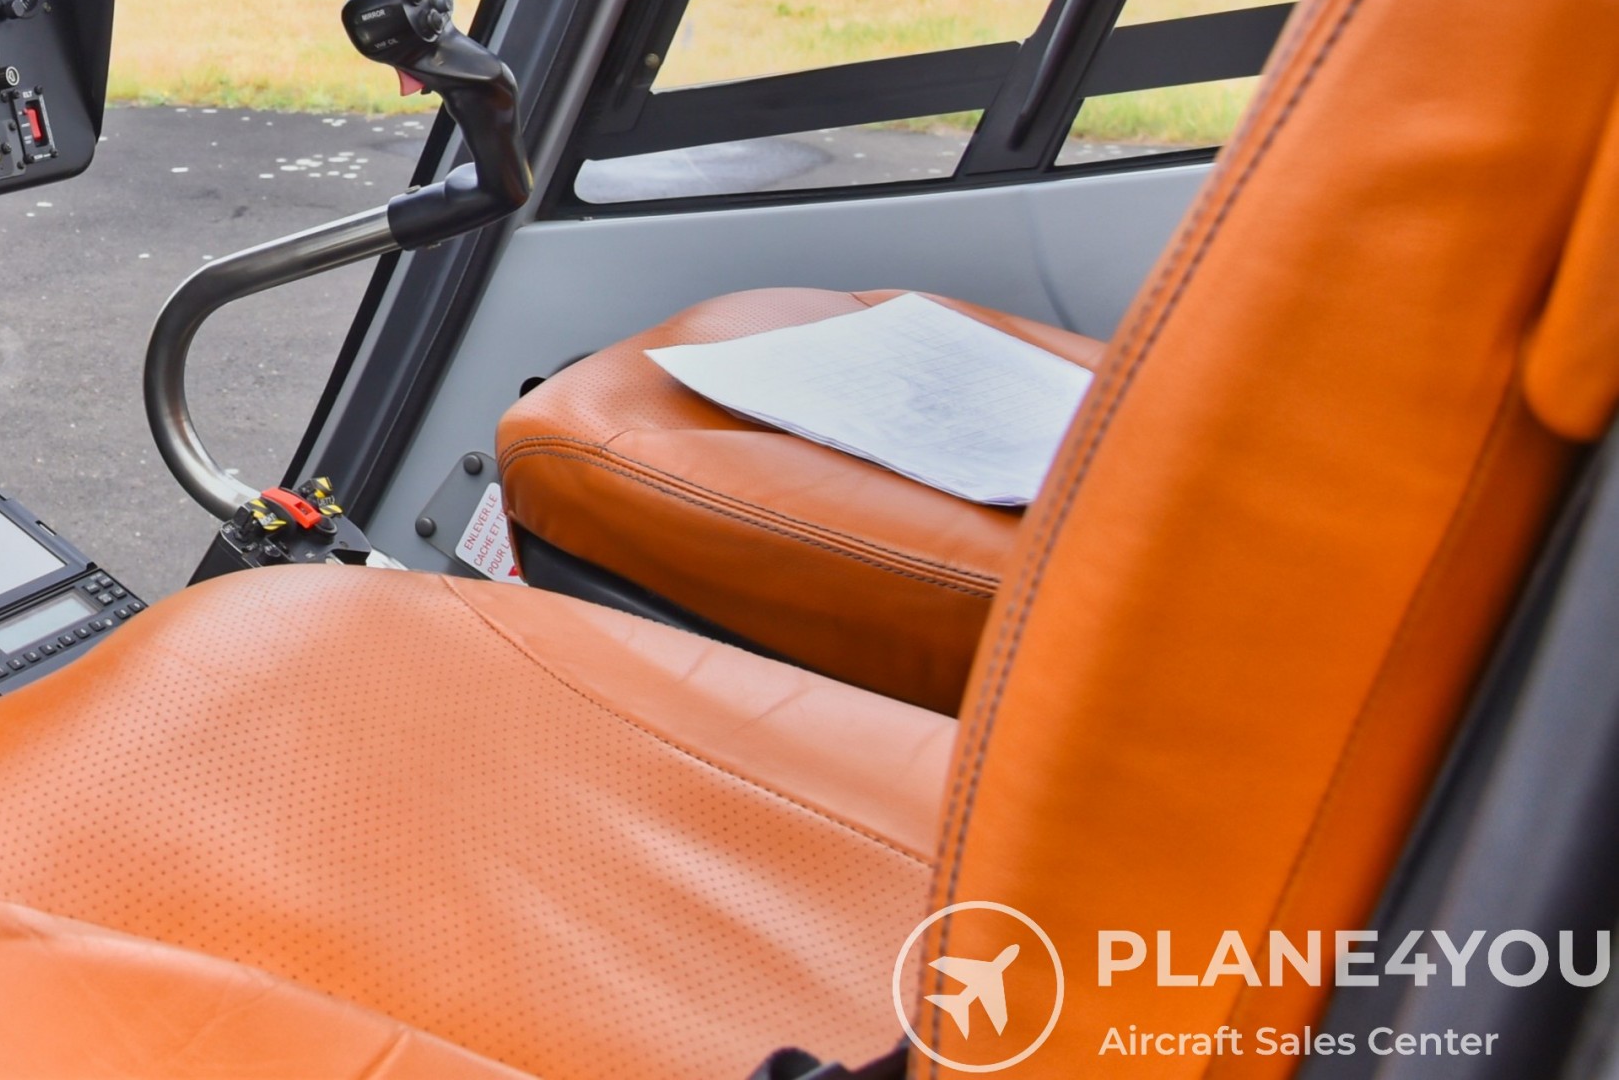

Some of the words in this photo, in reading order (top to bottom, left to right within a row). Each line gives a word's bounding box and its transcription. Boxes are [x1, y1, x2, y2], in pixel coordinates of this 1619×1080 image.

[361, 9, 386, 21] MIRROR
[23, 90, 34, 98] ELT
[463, 507, 491, 551] ENLEVER
[486, 493, 498, 508] LE
[473, 535, 495, 567] CACHE
[489, 521, 503, 536] ET
[487, 550, 507, 576] POUR
